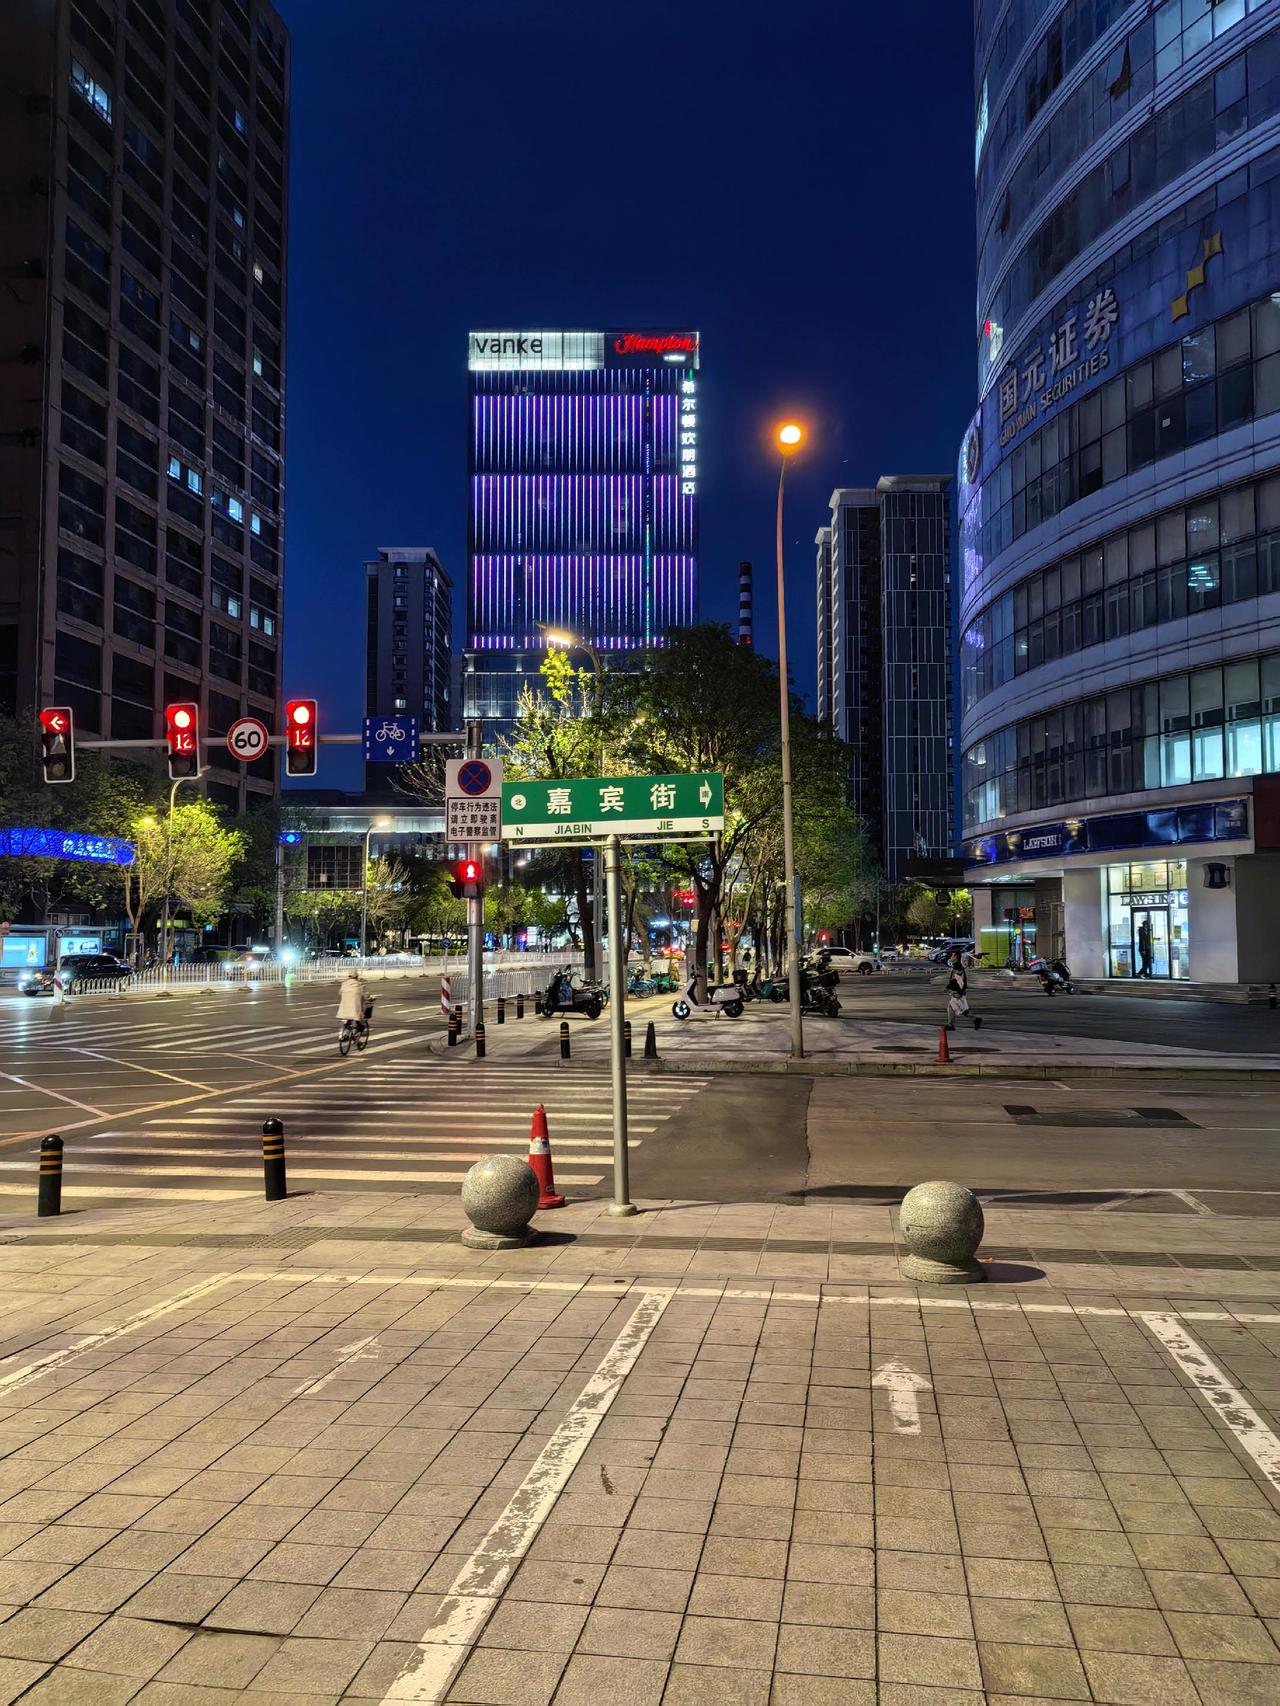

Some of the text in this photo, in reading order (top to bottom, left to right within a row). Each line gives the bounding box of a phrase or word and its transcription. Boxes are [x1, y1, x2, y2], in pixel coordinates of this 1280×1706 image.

[475, 336, 542, 354] vanke
[614, 333, 698, 355] Hampton
[999, 289, 1118, 426] 国元证券
[1040, 349, 1109, 411] SECURITIES
[176, 733, 192, 750] 12
[234, 731, 260, 749] 60
[295, 729, 311, 746] 12
[450, 801, 498, 812] 停车行为违法
[514, 798, 523, 806] 北
[546, 784, 676, 815] 嘉宾街
[450, 814, 497, 825] 请立即驶离
[515, 819, 710, 836] N JIABIN JIE S
[450, 826, 497, 837] 电子警察监管
[1023, 834, 1057, 850] LAWSON
